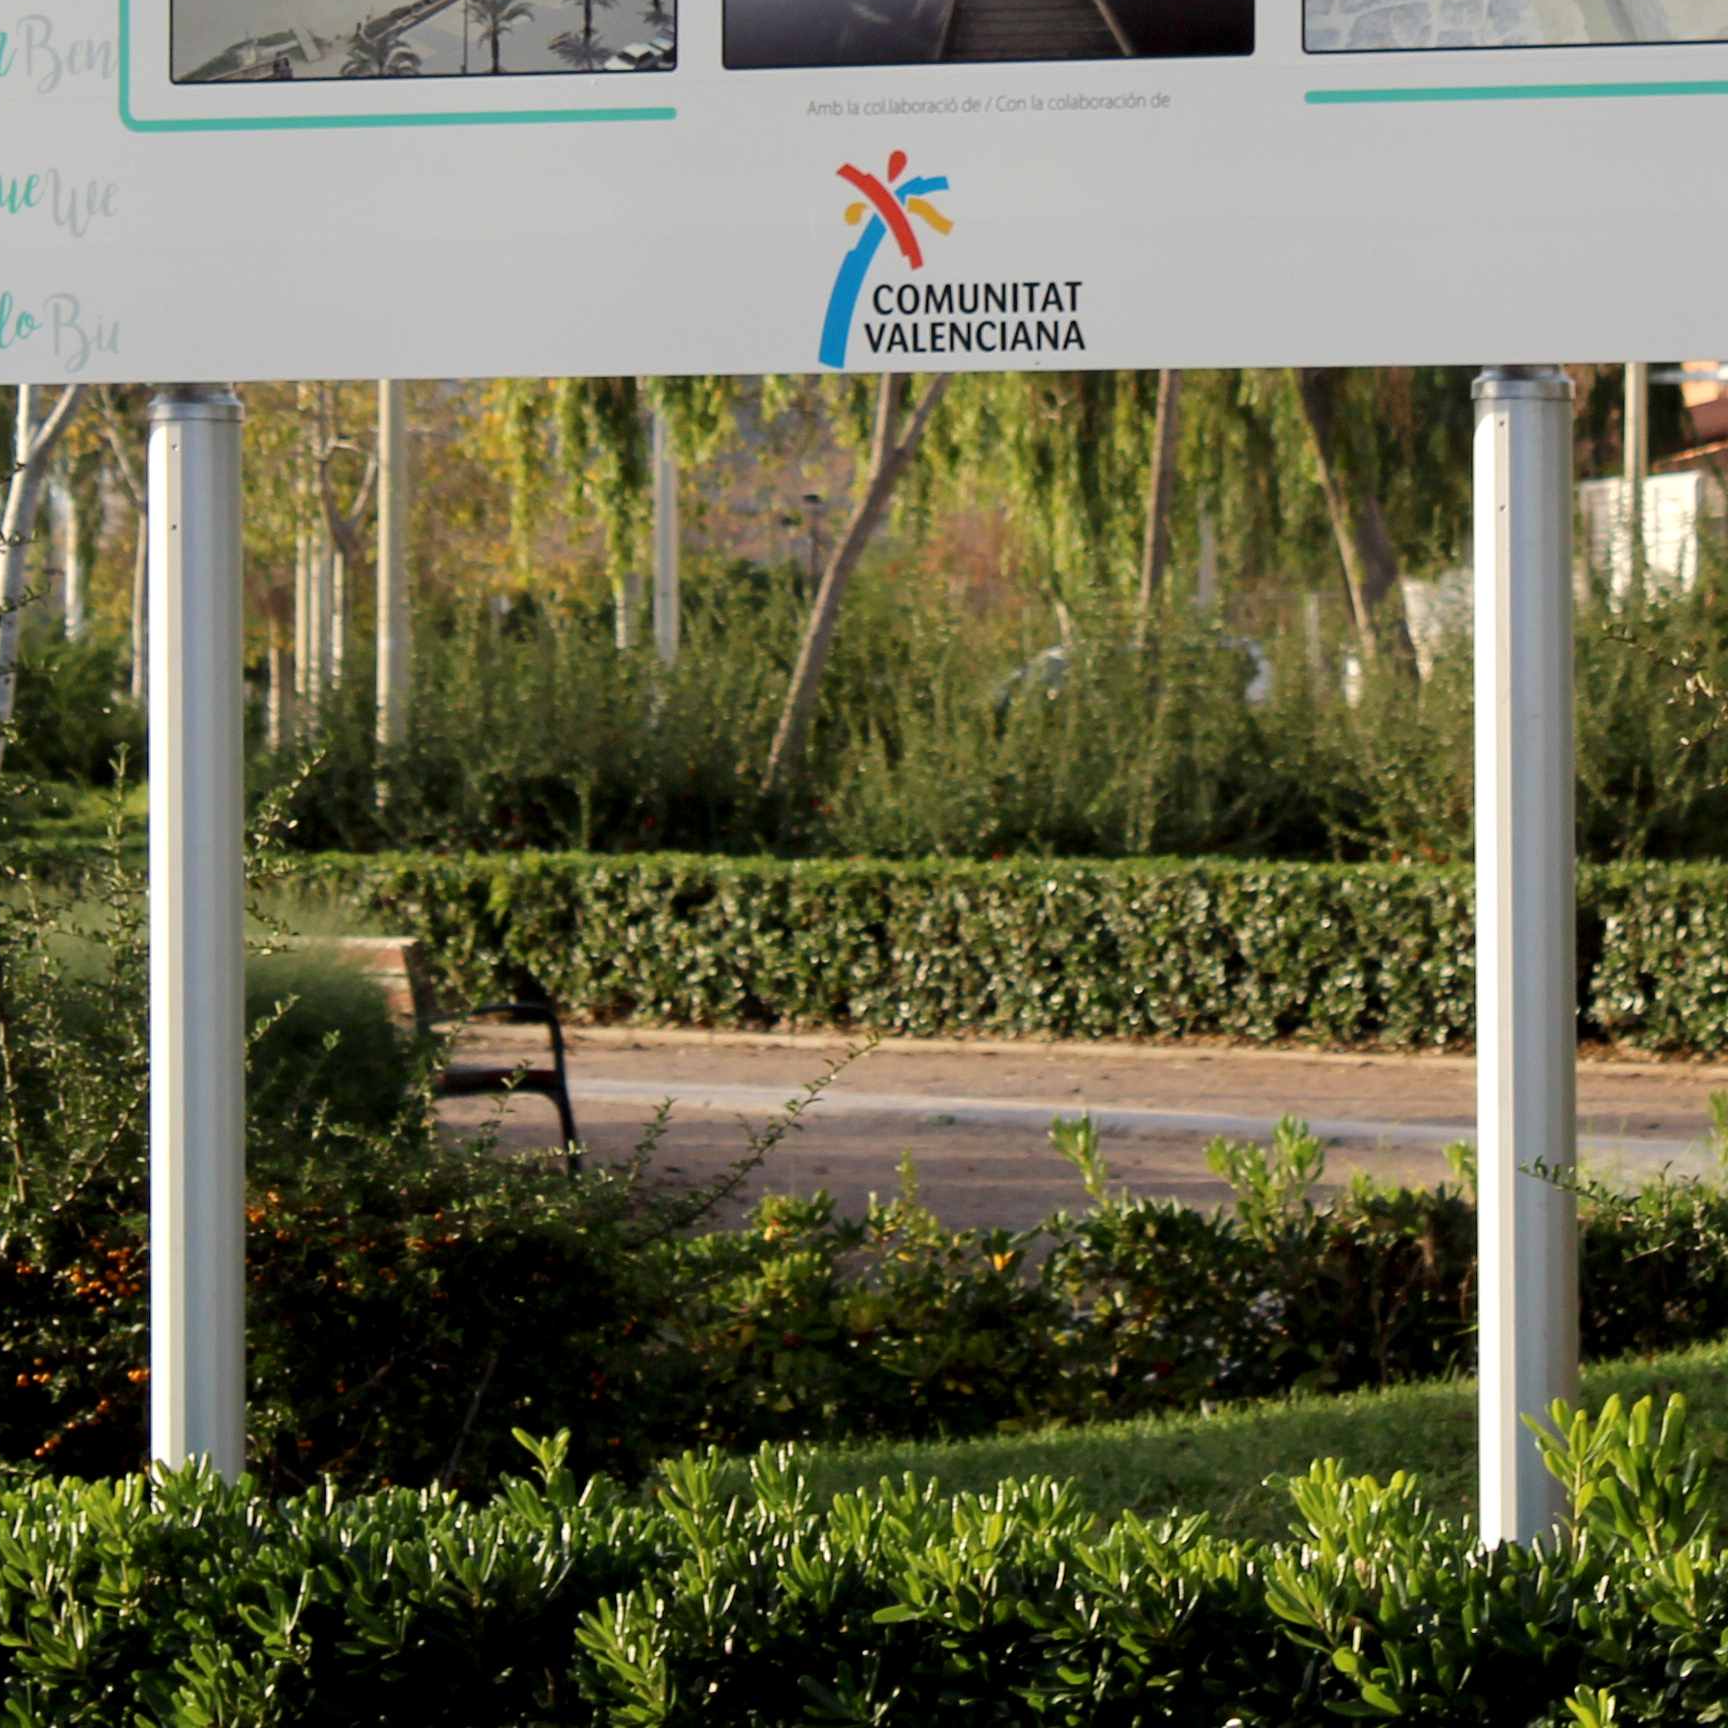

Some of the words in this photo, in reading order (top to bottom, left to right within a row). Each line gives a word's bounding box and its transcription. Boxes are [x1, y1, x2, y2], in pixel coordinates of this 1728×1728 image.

[806, 99, 844, 117] Amb
[846, 98, 860, 116] la
[961, 94, 981, 113] de
[995, 95, 1027, 113] Con
[1030, 94, 1044, 111] la
[1047, 92, 1147, 111] colaboración
[1149, 91, 1172, 109] de
[872, 280, 1084, 316] COMUNITAT
[864, 319, 1087, 354] VALENCIANA
